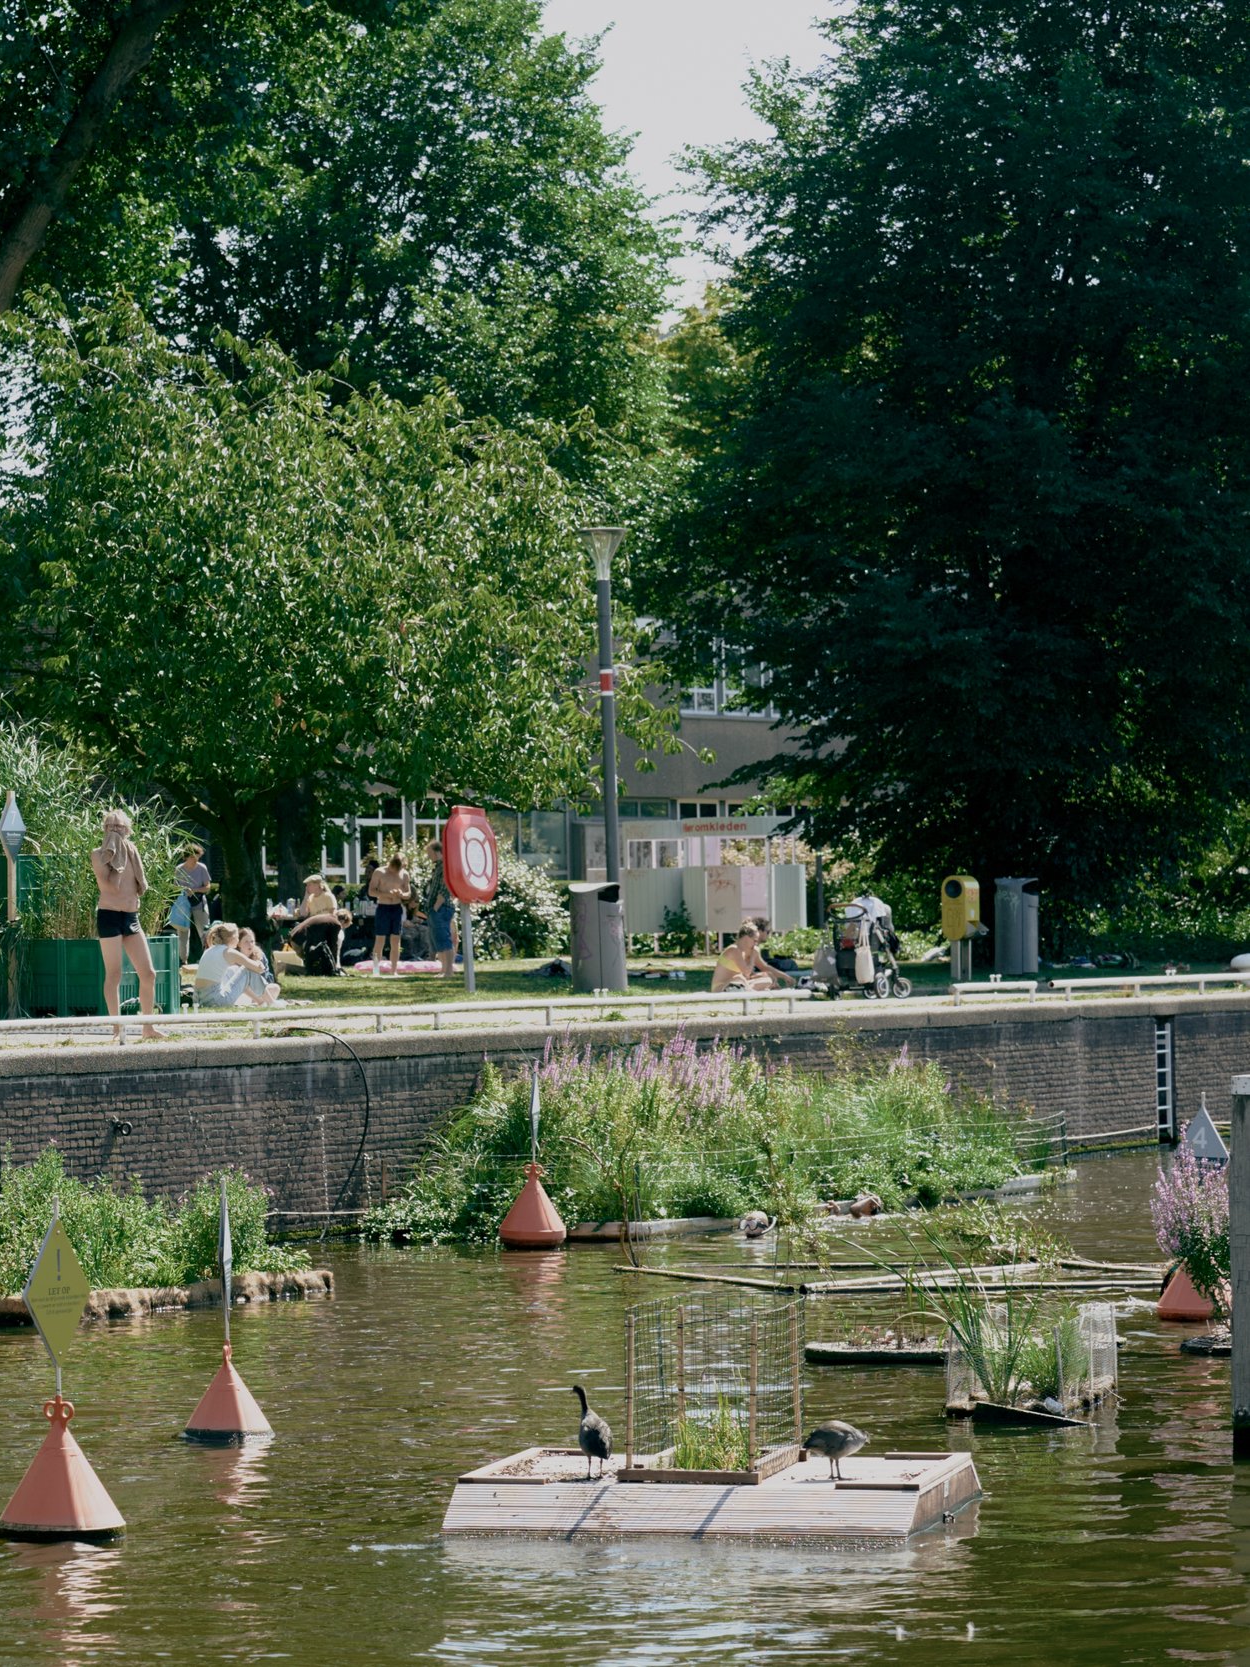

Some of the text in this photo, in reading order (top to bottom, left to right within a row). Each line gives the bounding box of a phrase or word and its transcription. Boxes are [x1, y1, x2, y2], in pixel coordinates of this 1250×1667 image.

[11, 811, 17, 824] 7
[1192, 1126, 1208, 1149] 4
[48, 1286, 71, 1296] LET OP
